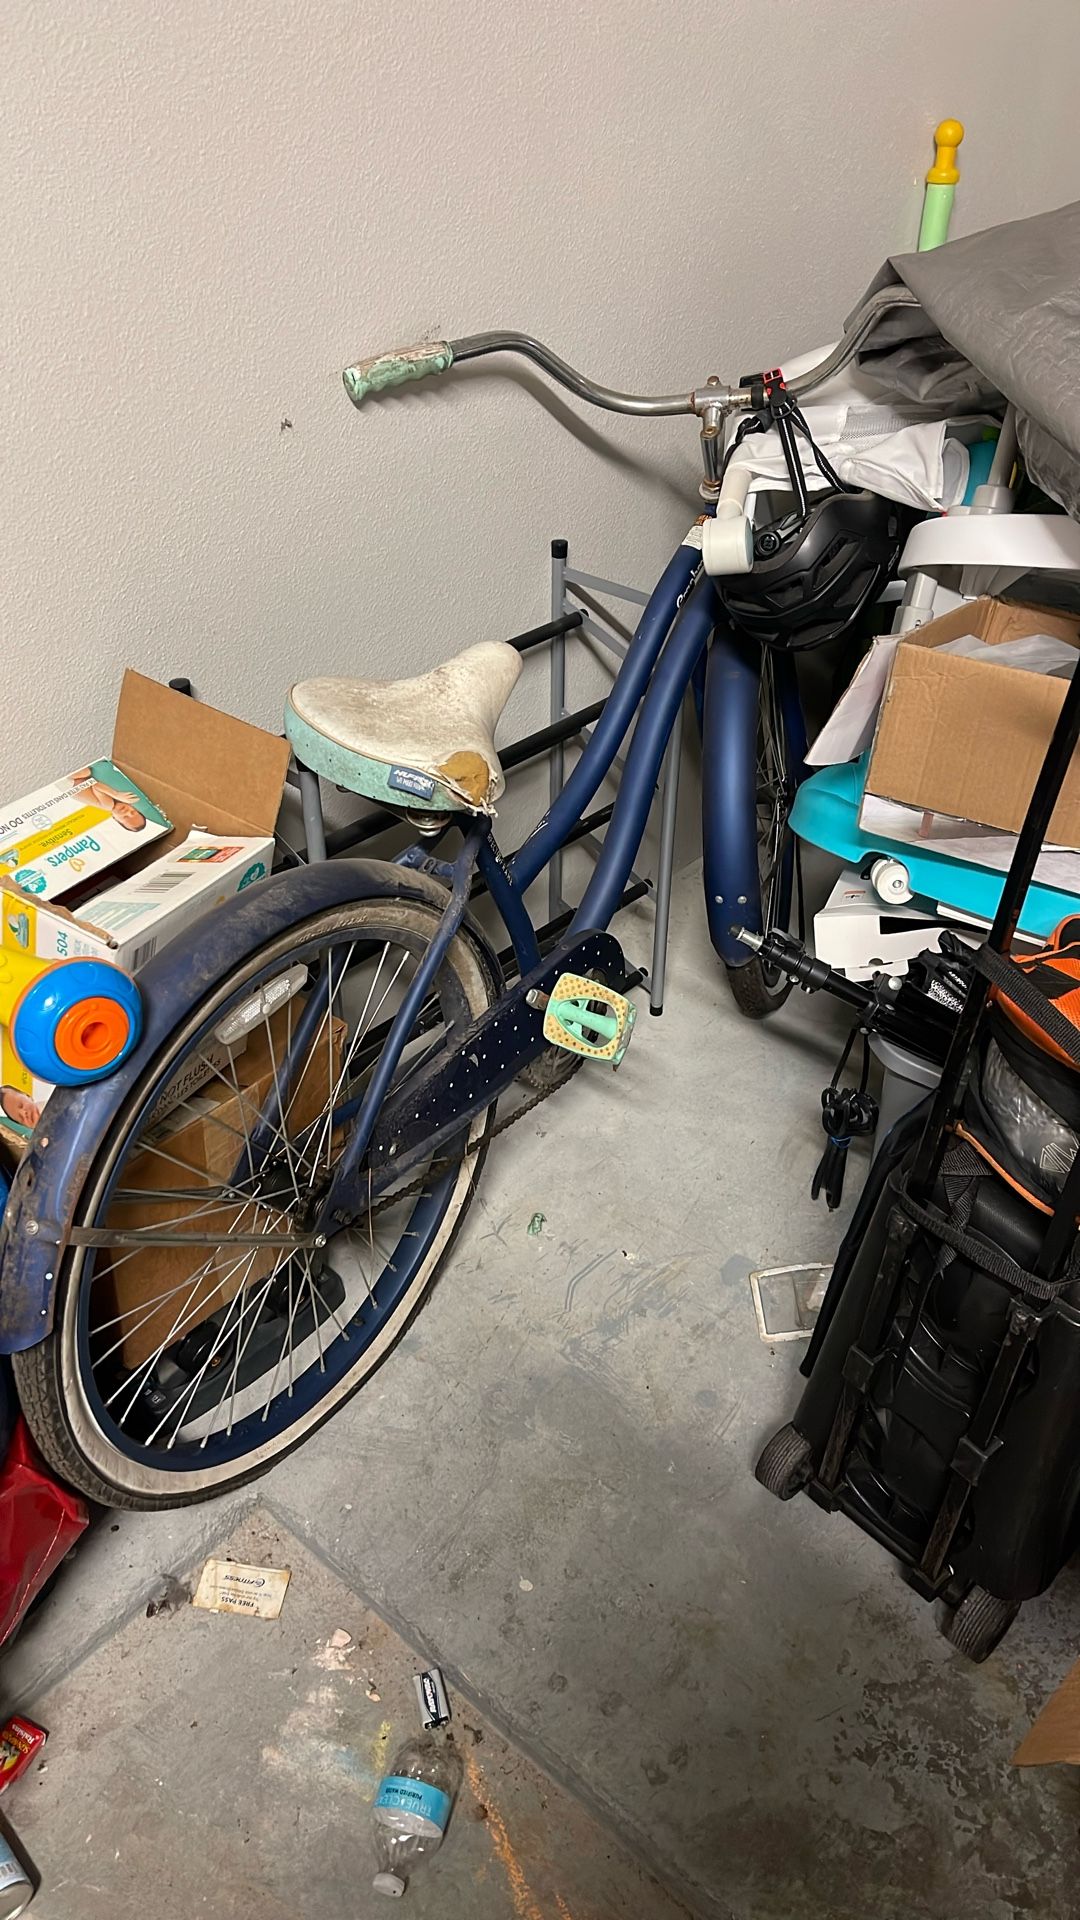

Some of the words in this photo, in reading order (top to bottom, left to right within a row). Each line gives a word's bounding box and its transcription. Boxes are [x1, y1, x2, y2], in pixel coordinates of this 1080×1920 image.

[45, 799, 55, 808] LES
[53, 792, 69, 803] DANS
[21, 804, 47, 820] TOILETTES
[8, 816, 25, 828] DO
[46, 835, 102, 867] Pampers
[56, 931, 69, 957] 504
[182, 1053, 214, 1087] FLUSH
[224, 1574, 256, 1585] FITNESS
[221, 1596, 238, 1605] PASS
[239, 1599, 255, 1608] FREE
[12, 1723, 35, 1745] Raisins
[399, 1788, 424, 1801] PURIFIED
[406, 1799, 433, 1817] TRUE
